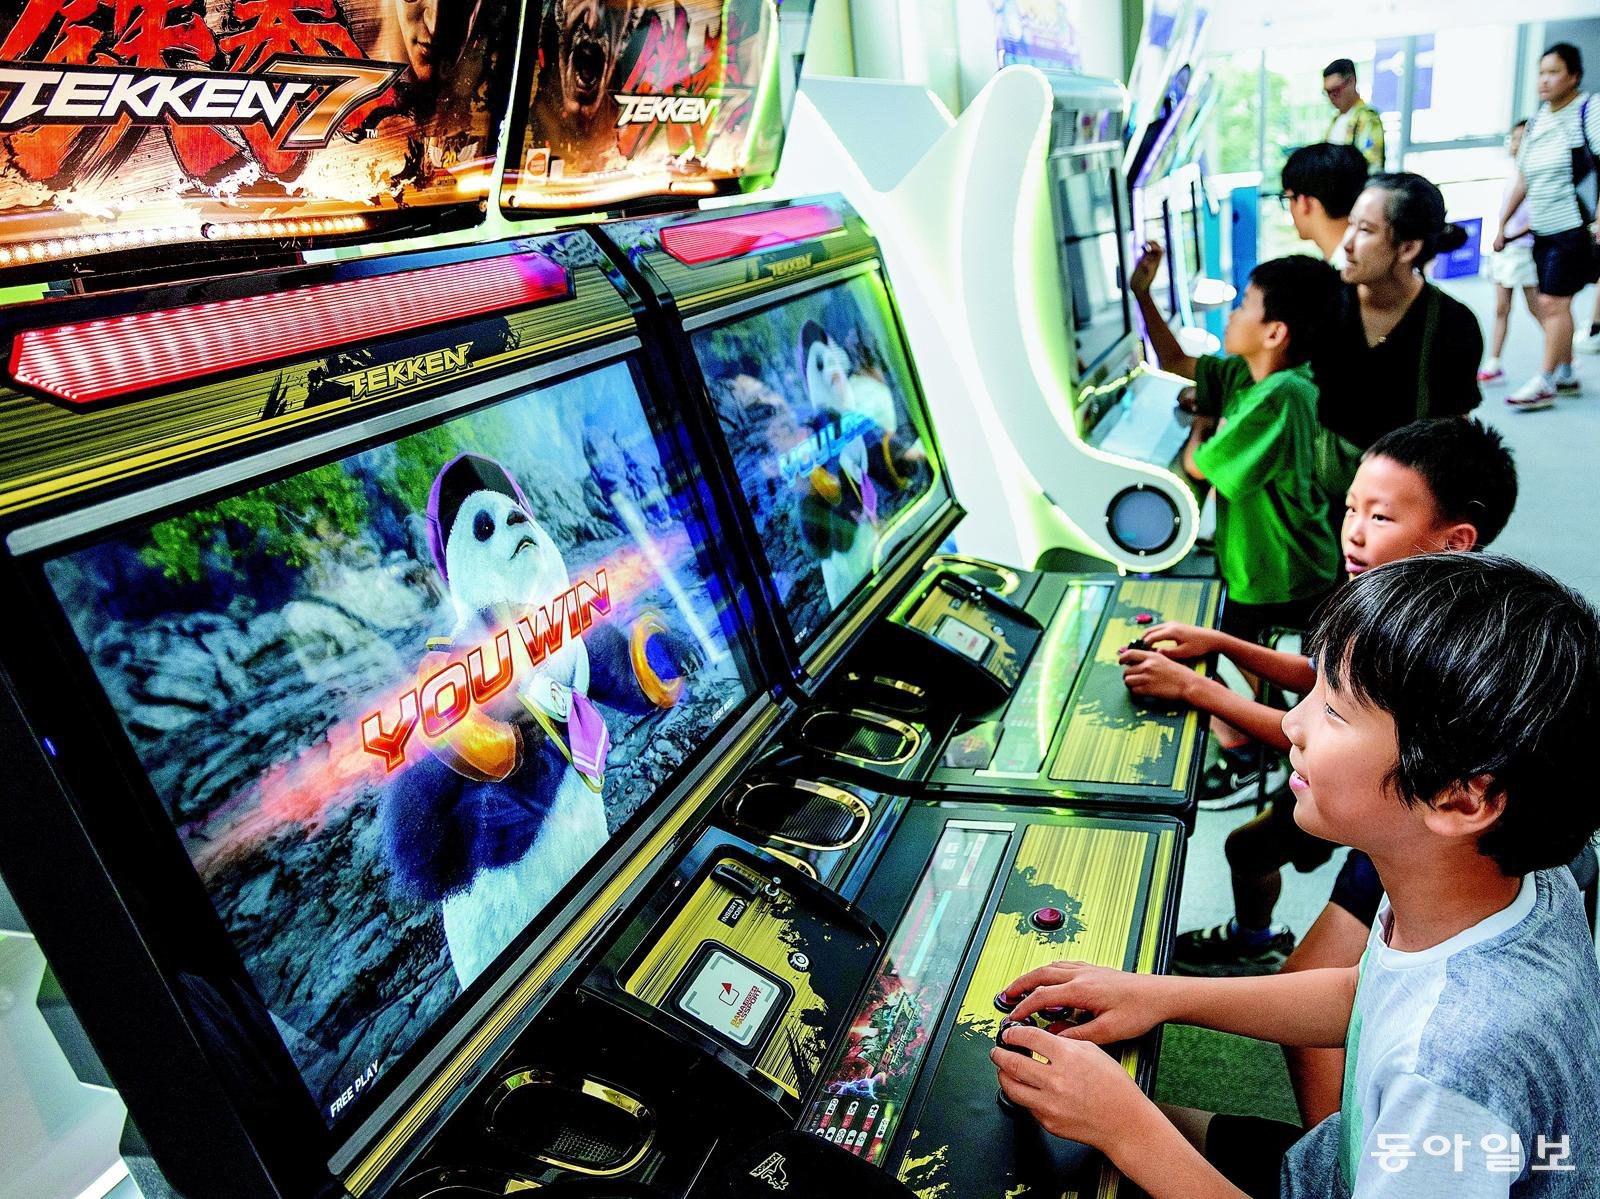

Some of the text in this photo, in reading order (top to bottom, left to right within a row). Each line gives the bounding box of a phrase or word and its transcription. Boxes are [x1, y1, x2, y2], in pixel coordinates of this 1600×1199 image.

[0, 55, 406, 149] TEKKEN 7
[614, 94, 721, 127] TEKKEN
[365, 128, 379, 139] TM
[764, 253, 812, 277] TEKKEN
[326, 342, 474, 400] TEKKEN
[360, 568, 611, 774] YOU WIN
[721, 901, 737, 922] INSERT
[731, 905, 744, 920] COIN
[735, 989, 762, 1029] PASSPORT
[330, 1059, 378, 1118] FREE PLAY
